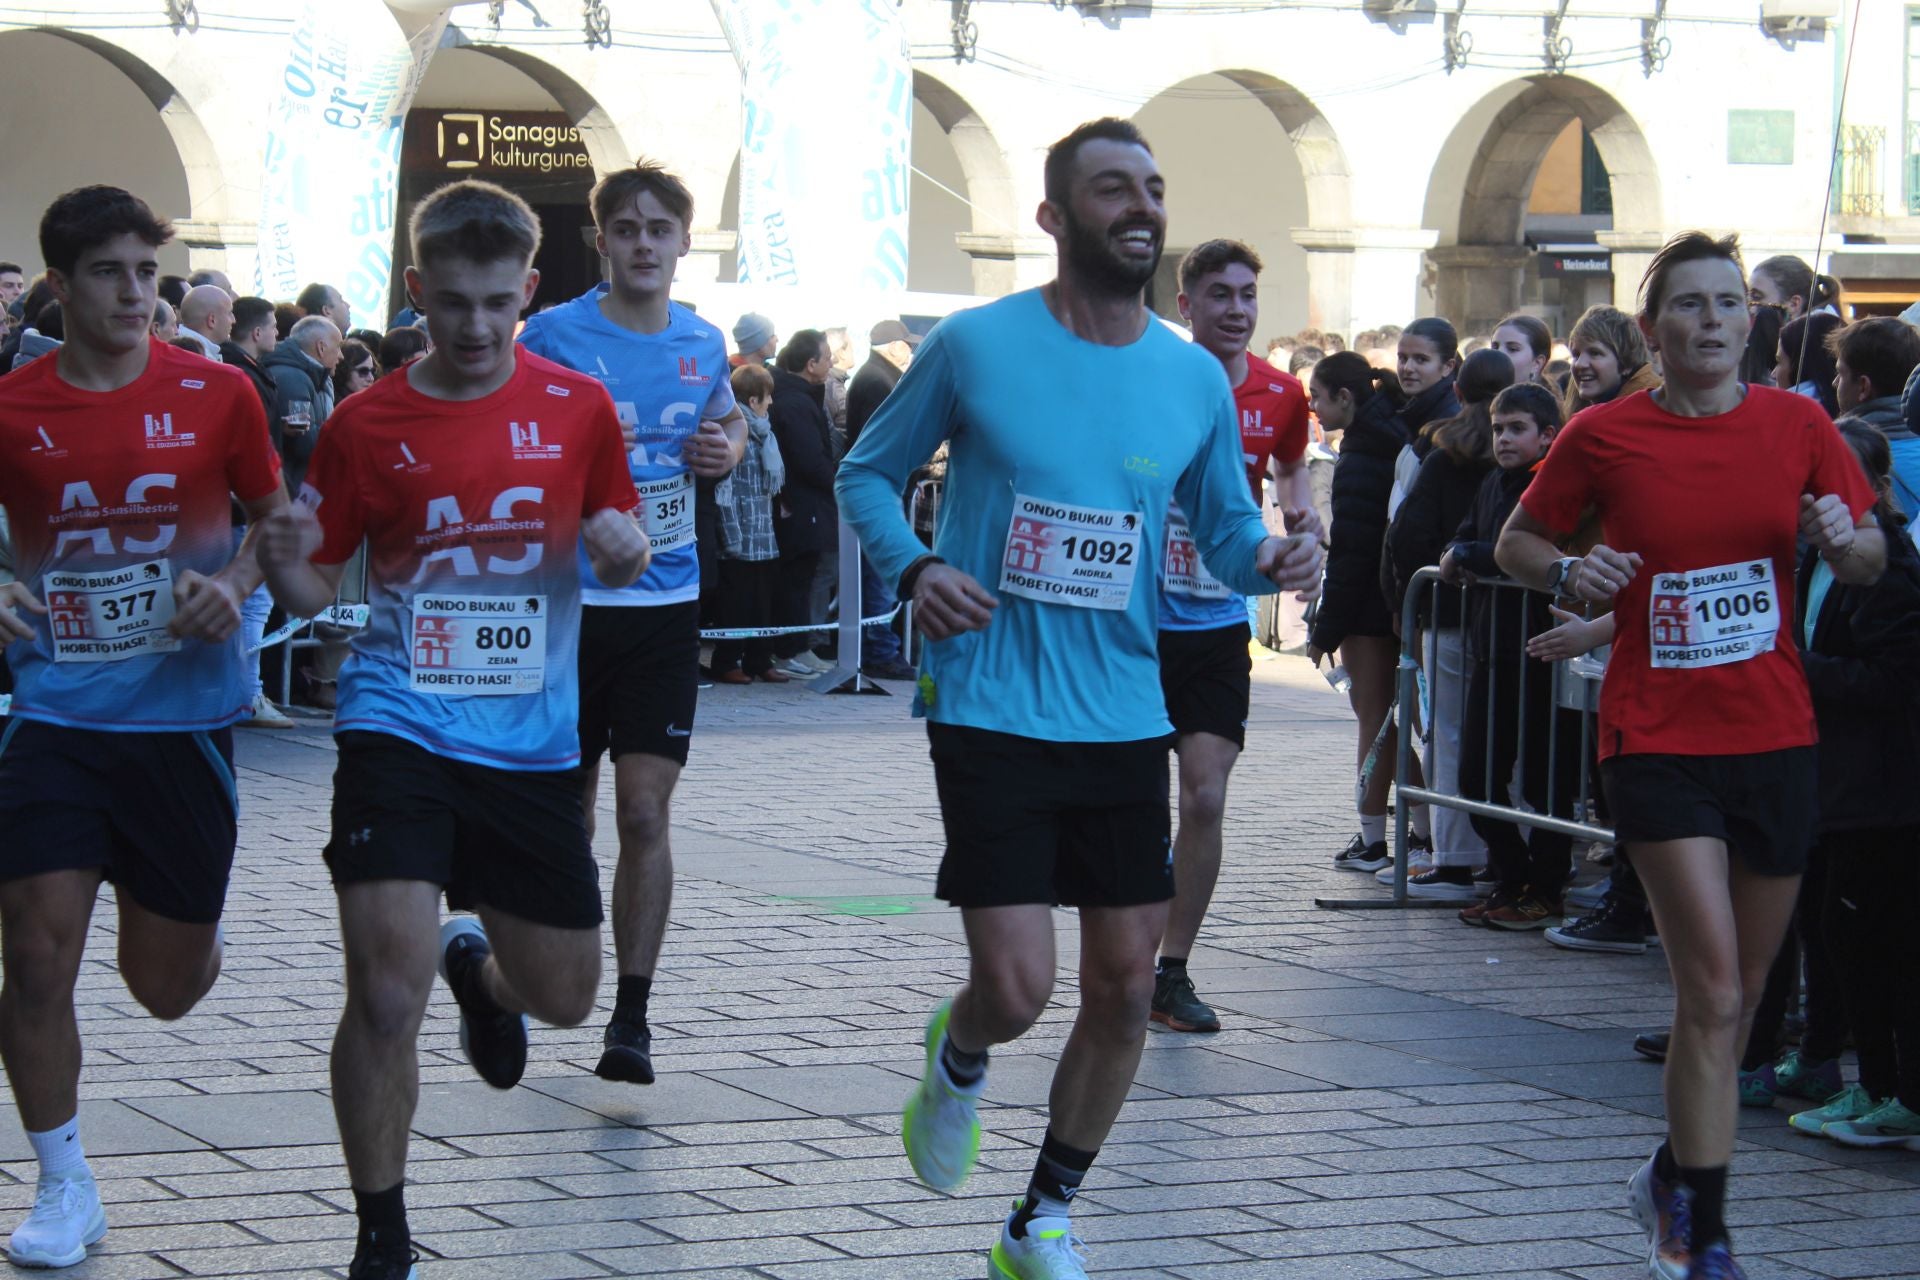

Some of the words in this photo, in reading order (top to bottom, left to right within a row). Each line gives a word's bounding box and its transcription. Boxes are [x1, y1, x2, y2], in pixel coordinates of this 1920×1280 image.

[1562, 258, 1609, 271] Heineken
[650, 480, 679, 493] BUKAU
[102, 502, 179, 517] Sansilbestrie
[657, 495, 686, 520] 351
[1023, 502, 1066, 519] ONDO
[1068, 511, 1114, 526] BUKAU
[465, 518, 545, 534] Sansilbestrie
[660, 534, 679, 546] HASI!
[1062, 536, 1134, 566] 1092
[52, 576, 88, 588] ONDO
[89, 572, 134, 588] BUKAU
[1072, 568, 1113, 579] ANDREA
[1692, 571, 1739, 587] BUKAU
[1006, 572, 1063, 594] HOBETO
[1065, 585, 1099, 598] HASI!
[101, 590, 157, 620] 377
[423, 599, 467, 611] ONDO
[469, 602, 516, 612] BUKAU
[1695, 591, 1771, 623] 1006
[117, 619, 150, 633] PELLO
[60, 642, 111, 654] HOBETO
[113, 636, 147, 652] HASI!
[475, 626, 532, 650] 800
[1656, 648, 1713, 661] HOBETO
[1714, 641, 1751, 656] HASI!
[487, 656, 518, 665] ZEIAN
[416, 673, 475, 685] HOBETO
[477, 675, 512, 685] HASI!
